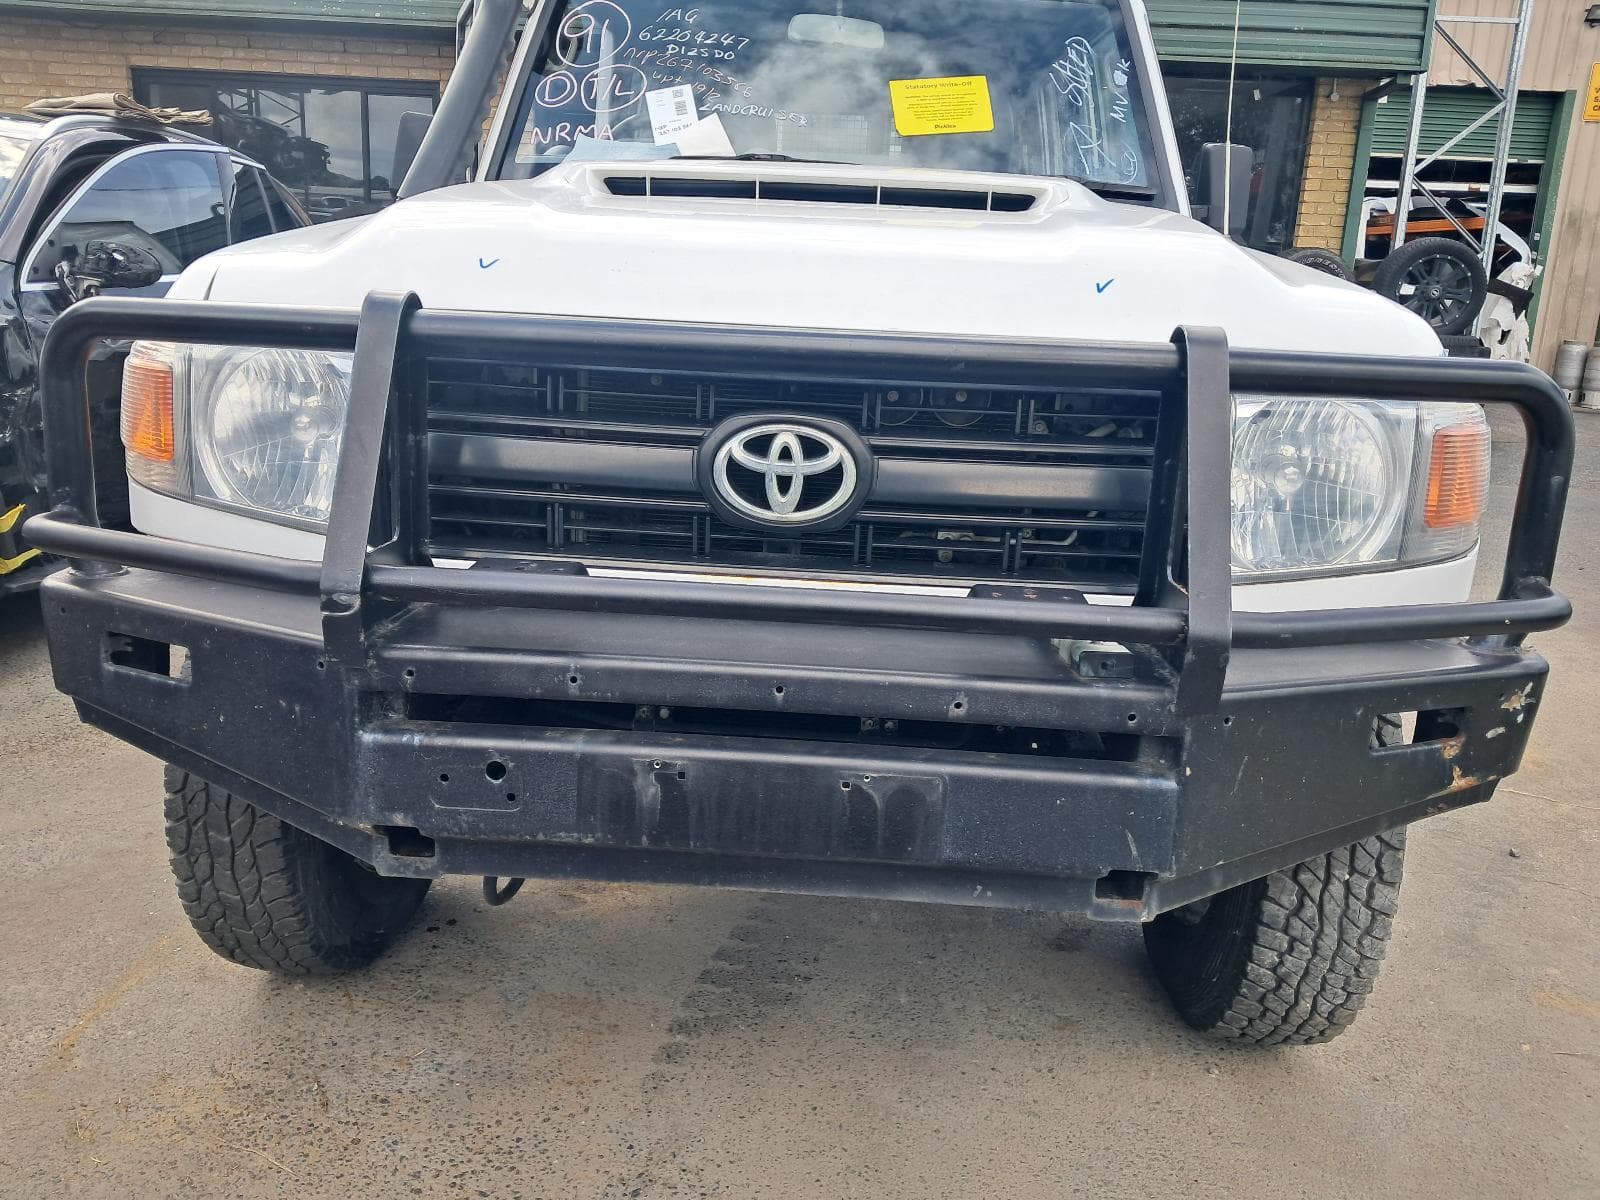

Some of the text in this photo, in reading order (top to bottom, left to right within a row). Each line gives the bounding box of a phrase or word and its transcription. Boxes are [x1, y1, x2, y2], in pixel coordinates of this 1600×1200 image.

[656, 8, 699, 24] IAG
[563, 13, 611, 54] 91
[638, 25, 750, 50] 62204247
[544, 75, 571, 102] D
[531, 122, 613, 144] NRMA
